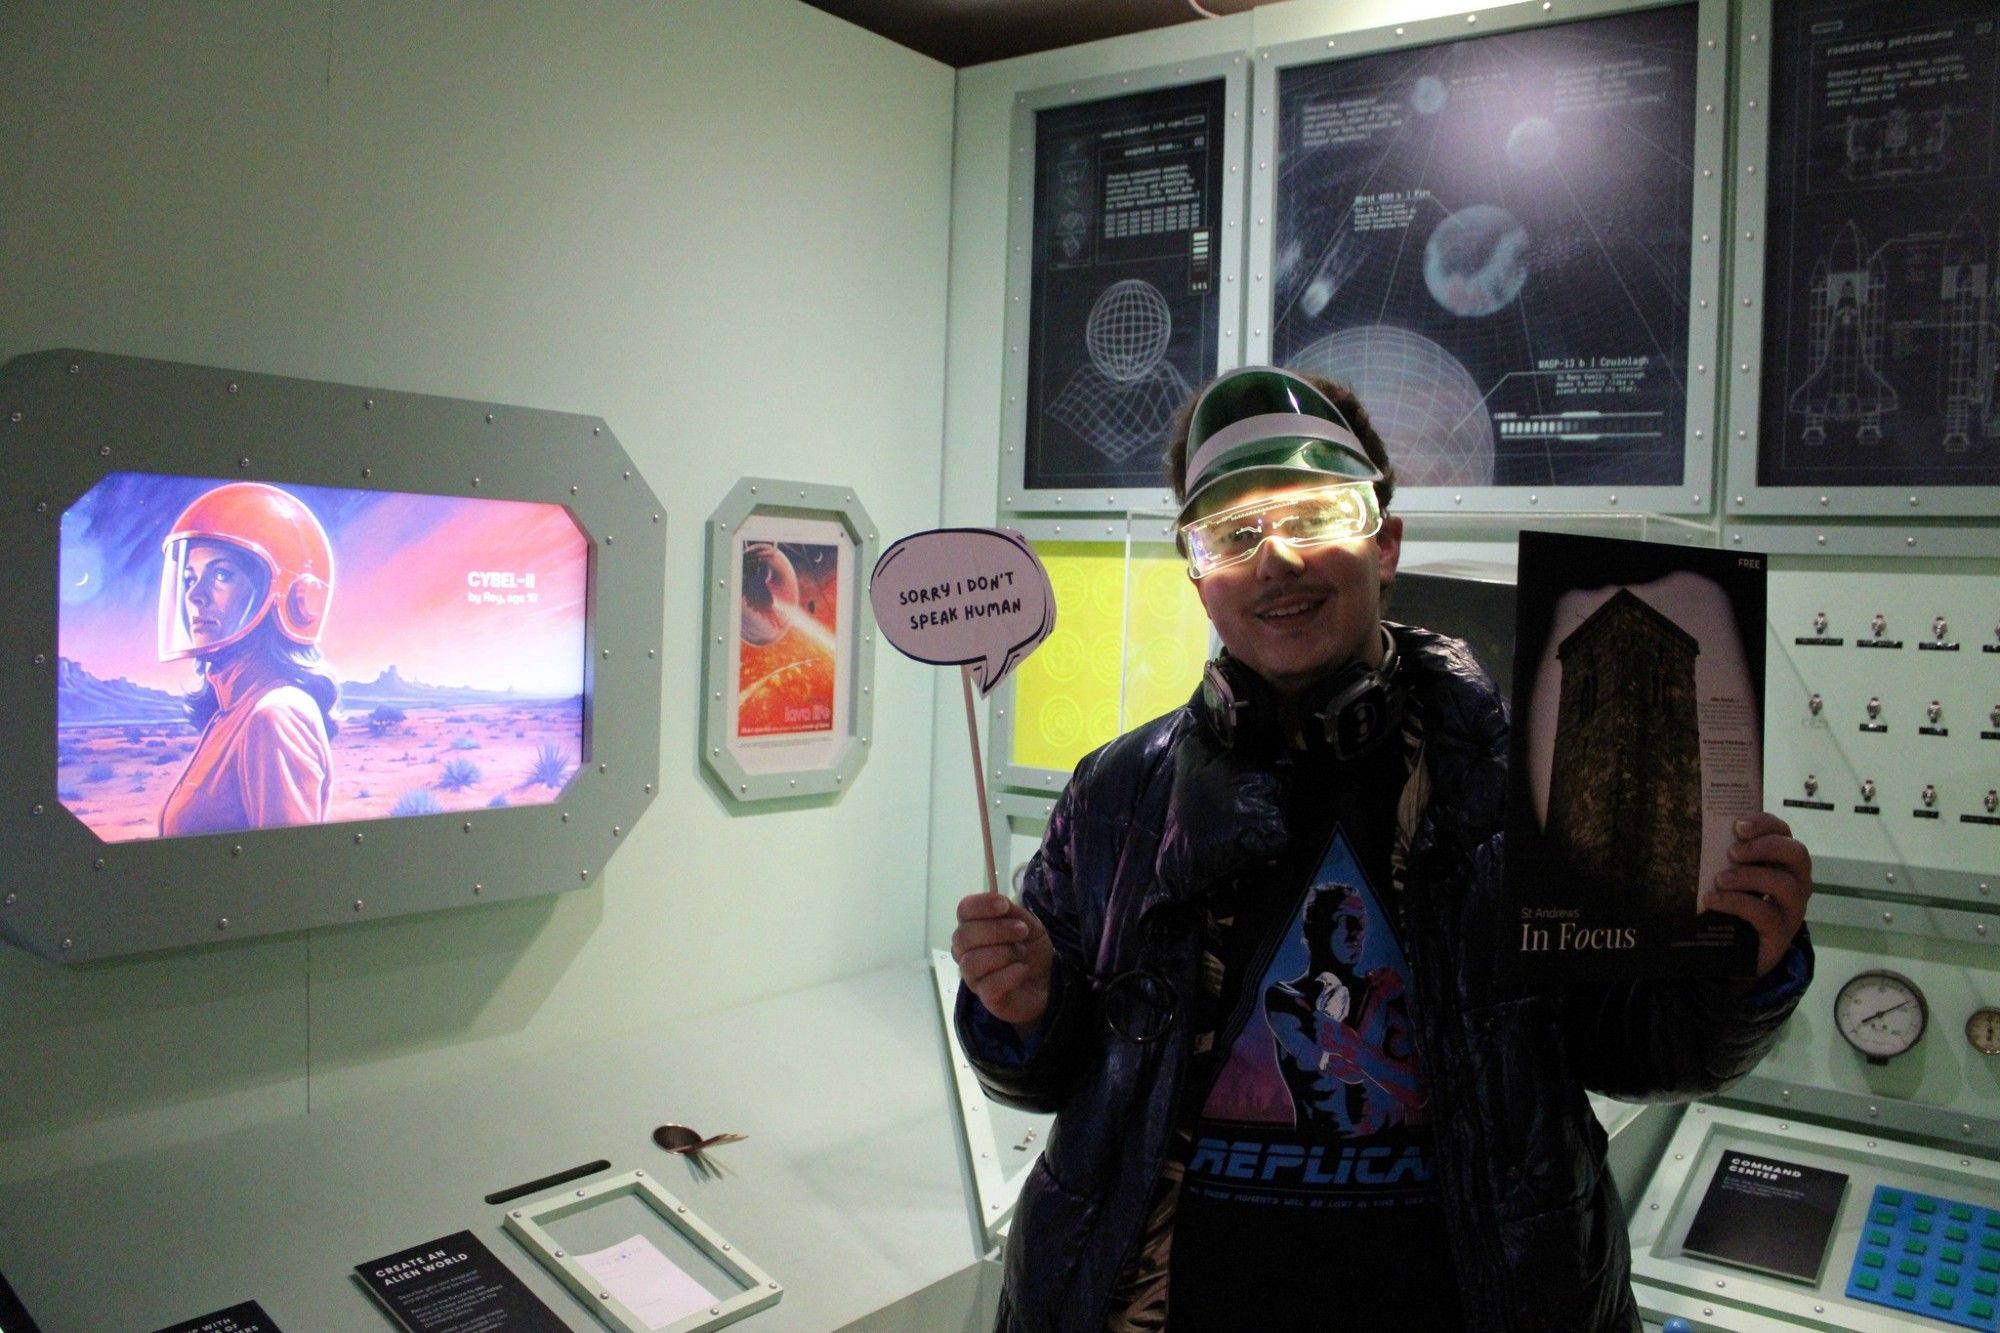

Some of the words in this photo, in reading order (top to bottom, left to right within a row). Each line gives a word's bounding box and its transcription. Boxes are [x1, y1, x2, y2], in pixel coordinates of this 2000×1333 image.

[1738, 558, 1760, 569] FREE
[900, 582, 950, 605] SORRY
[957, 582, 962, 595] I
[967, 572, 1014, 592] DON'T
[468, 592, 481, 605] by
[910, 607, 958, 630] SPEAK
[965, 598, 1021, 620] HUMAN
[1521, 908, 1532, 919] St
[1534, 907, 1580, 919] Andrews
[1520, 923, 1550, 951] In
[1558, 922, 1636, 951] Focus
[1728, 1165, 1778, 1181] CENTER
[1731, 1158, 1802, 1178] COMMAND
[375, 1257, 425, 1277] CREATE
[428, 1250, 446, 1261] AN
[384, 1268, 421, 1286] ALIEN
[423, 1253, 468, 1272] WORLD
[202, 1318, 231, 1331] WITH
[224, 1323, 238, 1332] OF
